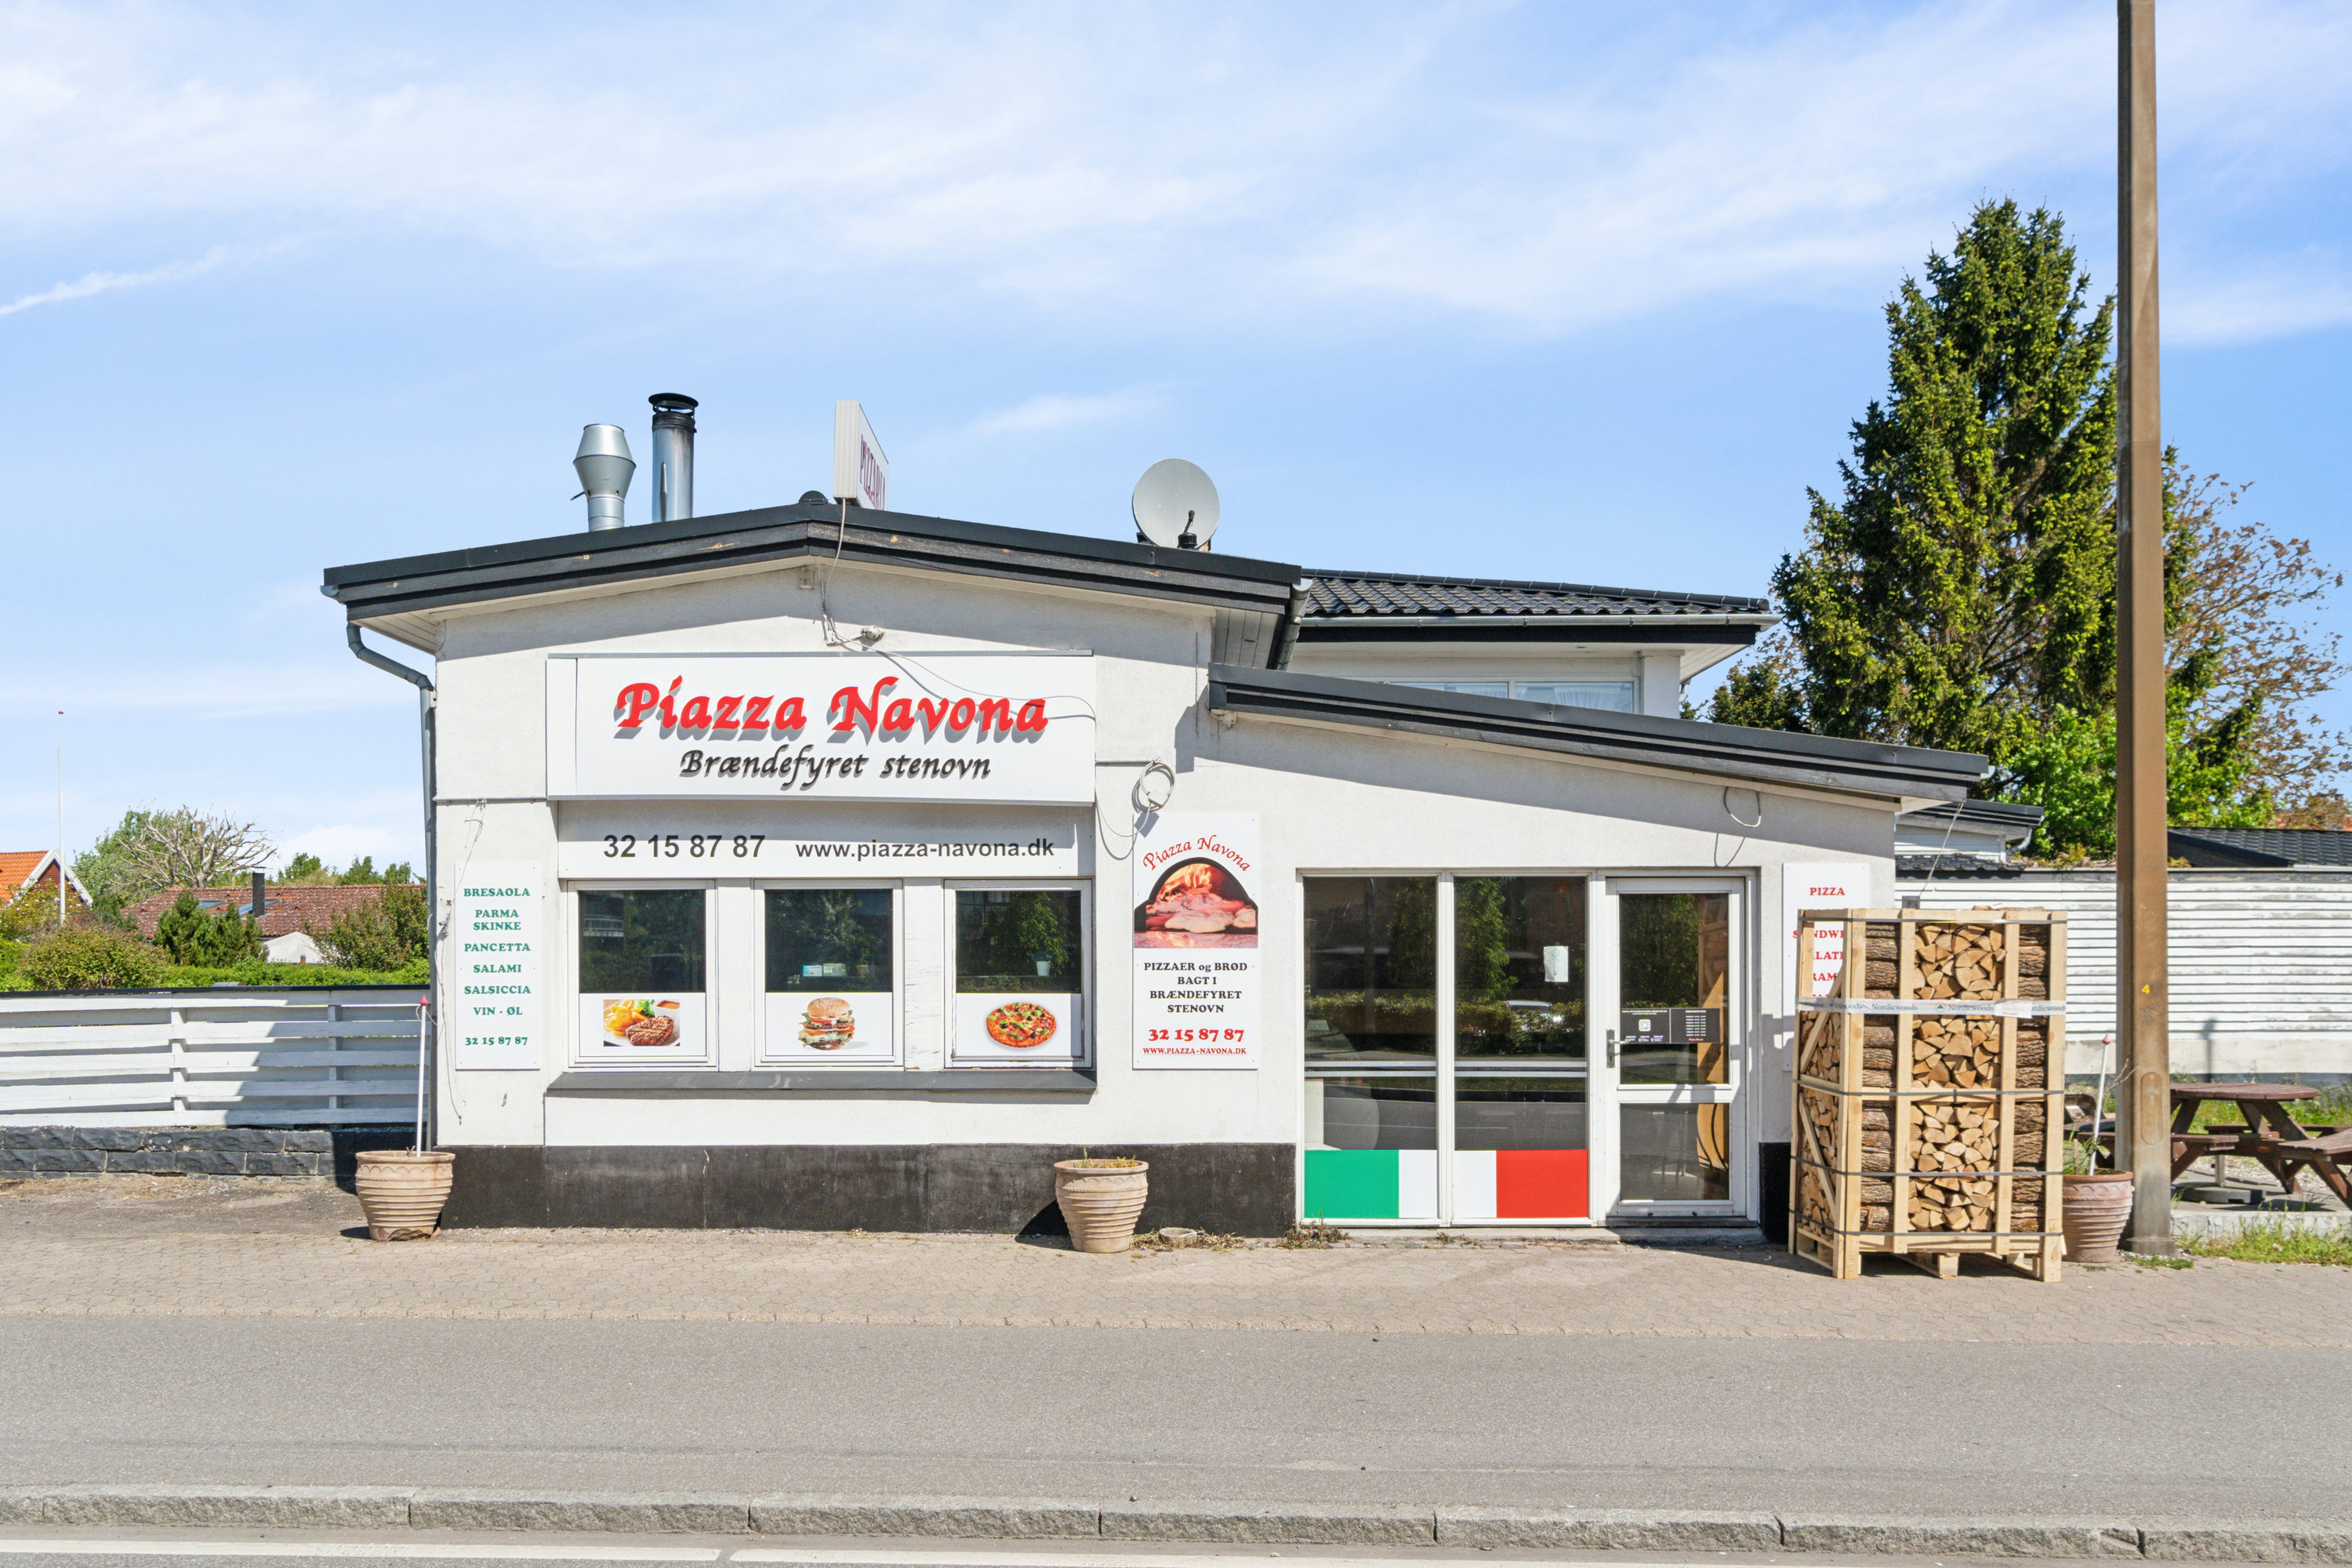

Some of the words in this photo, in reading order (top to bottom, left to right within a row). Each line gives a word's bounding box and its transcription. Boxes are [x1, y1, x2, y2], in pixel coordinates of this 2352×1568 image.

[615, 674, 807, 732] Piazza
[830, 676, 1049, 735] Navona
[681, 744, 868, 790] Brændefyret
[881, 754, 991, 779] stenovn
[603, 834, 636, 858] 32
[647, 834, 680, 858] 15
[689, 834, 723, 858] 87
[732, 834, 766, 858] 87
[795, 840, 1054, 861] www.piazza-navona.dk
[1142, 840, 1192, 871] Piazza
[1196, 833, 1250, 873] Navona
[463, 887, 531, 897] BRESAOLA
[1809, 887, 1846, 896] PIZZA
[475, 909, 519, 918] PARMA
[473, 922, 521, 931] SKINKE
[464, 943, 531, 952] PANCETTA
[473, 964, 521, 973] SALAMI
[1144, 963, 1196, 971] PIZZAER
[1198, 964, 1211, 973] og
[1214, 962, 1247, 971] BRØD
[463, 985, 531, 994] SALSICCIA
[1149, 990, 1242, 999] BRÆNDEFYRET
[2141, 984, 2151, 995] 4
[506, 1007, 523, 1016] ØL
[1167, 1004, 1225, 1013] STENOVN
[1149, 1029, 1170, 1042] 32
[1174, 1029, 1194, 1042] 15
[1198, 1028, 1219, 1042] 87
[1223, 1028, 1245, 1043] 87
[465, 1037, 479, 1046] 32
[482, 1037, 495, 1046] 15
[498, 1036, 510, 1045] 87
[514, 1036, 528, 1046] 87
